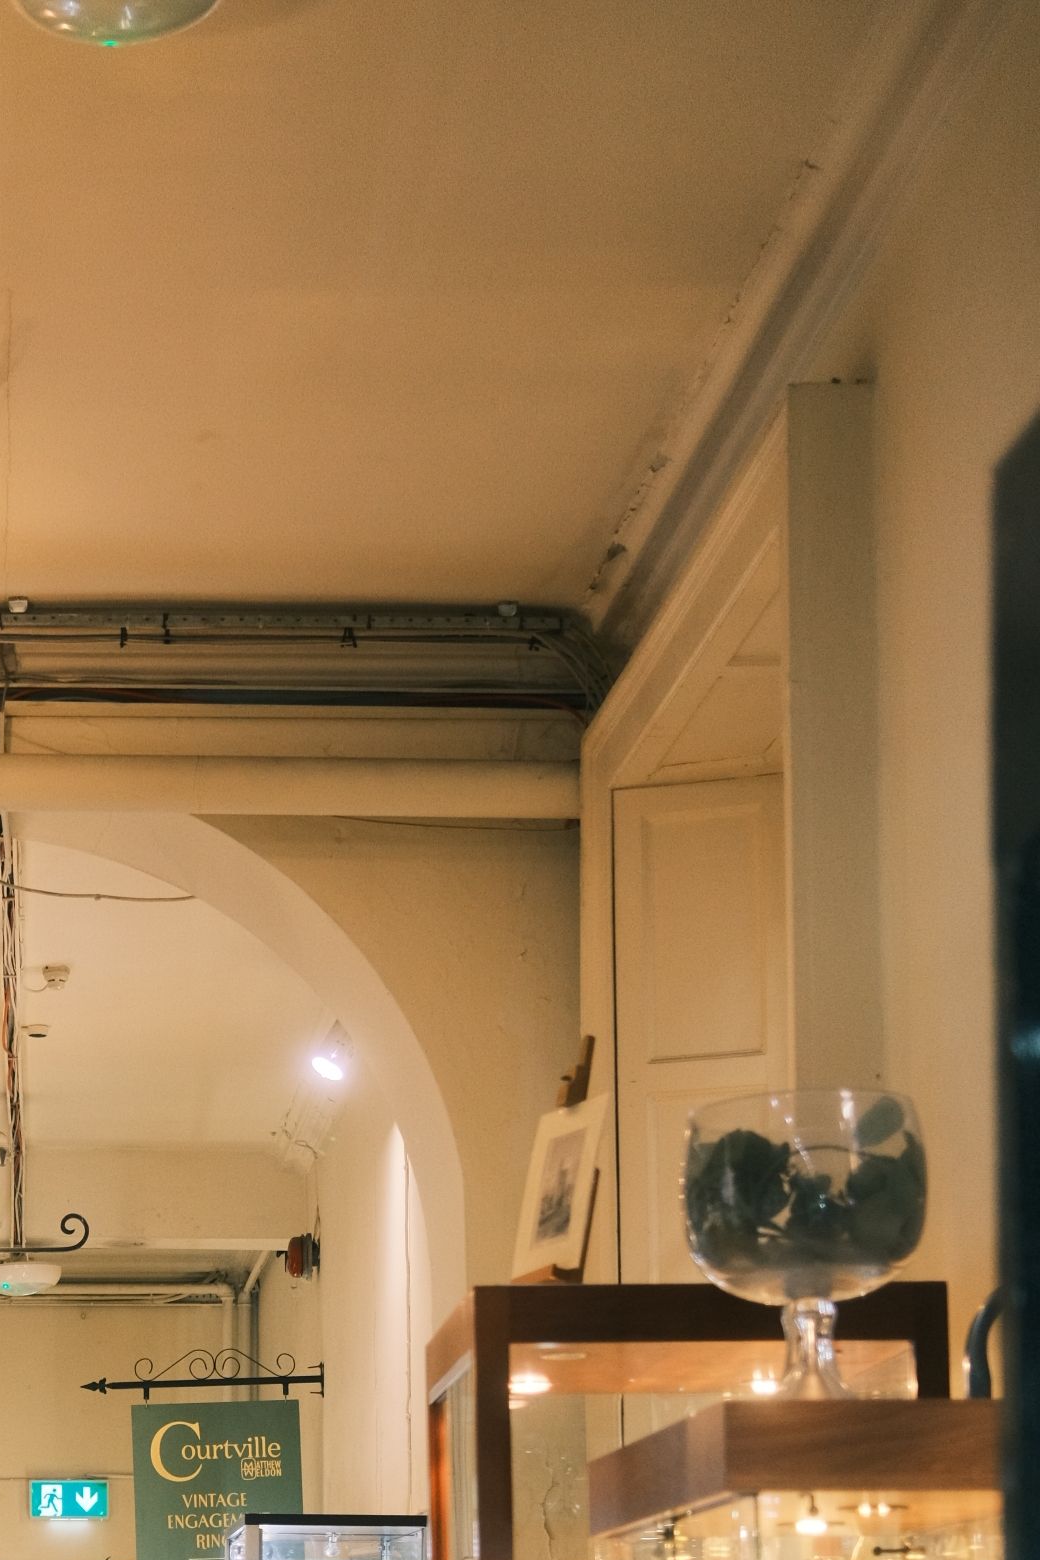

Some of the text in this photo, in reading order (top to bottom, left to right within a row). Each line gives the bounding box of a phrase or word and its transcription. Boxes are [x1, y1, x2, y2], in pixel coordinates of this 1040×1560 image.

[150, 1420, 282, 1483] Courtville
[182, 1492, 248, 1509] VINTAGE
[167, 1512, 243, 1530] ENGAGEM
[196, 1533, 226, 1550] RIN
